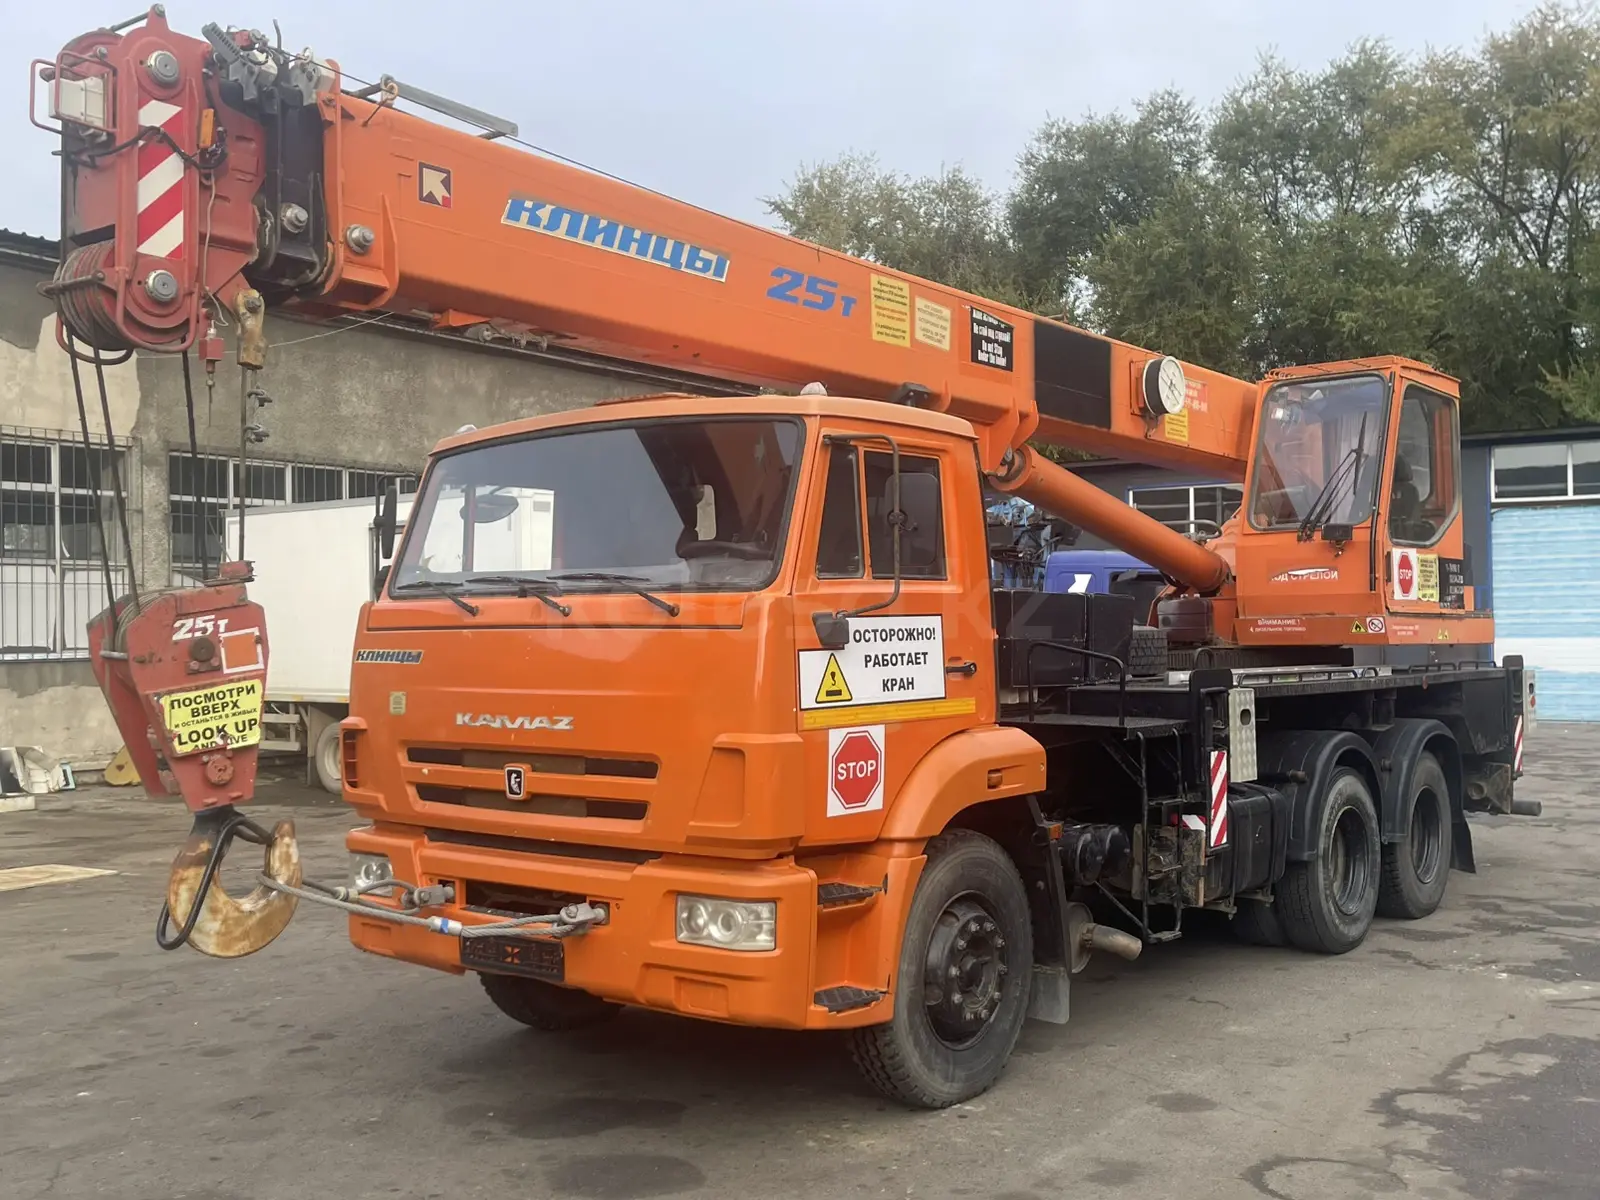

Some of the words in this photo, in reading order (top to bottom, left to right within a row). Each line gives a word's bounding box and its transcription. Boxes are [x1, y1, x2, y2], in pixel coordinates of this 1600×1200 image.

[1400, 569, 1413, 580] STOP
[853, 627, 936, 644] ОСТОРОЖНО!
[355, 650, 422, 664] КЛИНЦЫ
[864, 652, 929, 669] РАБОТАЕТ
[882, 677, 915, 692] КРАН
[170, 684, 256, 710] ПОСМОТРИ
[190, 699, 240, 718] ВВЕРХ
[455, 712, 574, 730] KAMAZ
[177, 723, 228, 746] LOOK
[234, 718, 258, 734] UP
[228, 734, 248, 745] IVE
[837, 759, 877, 781] STOP
